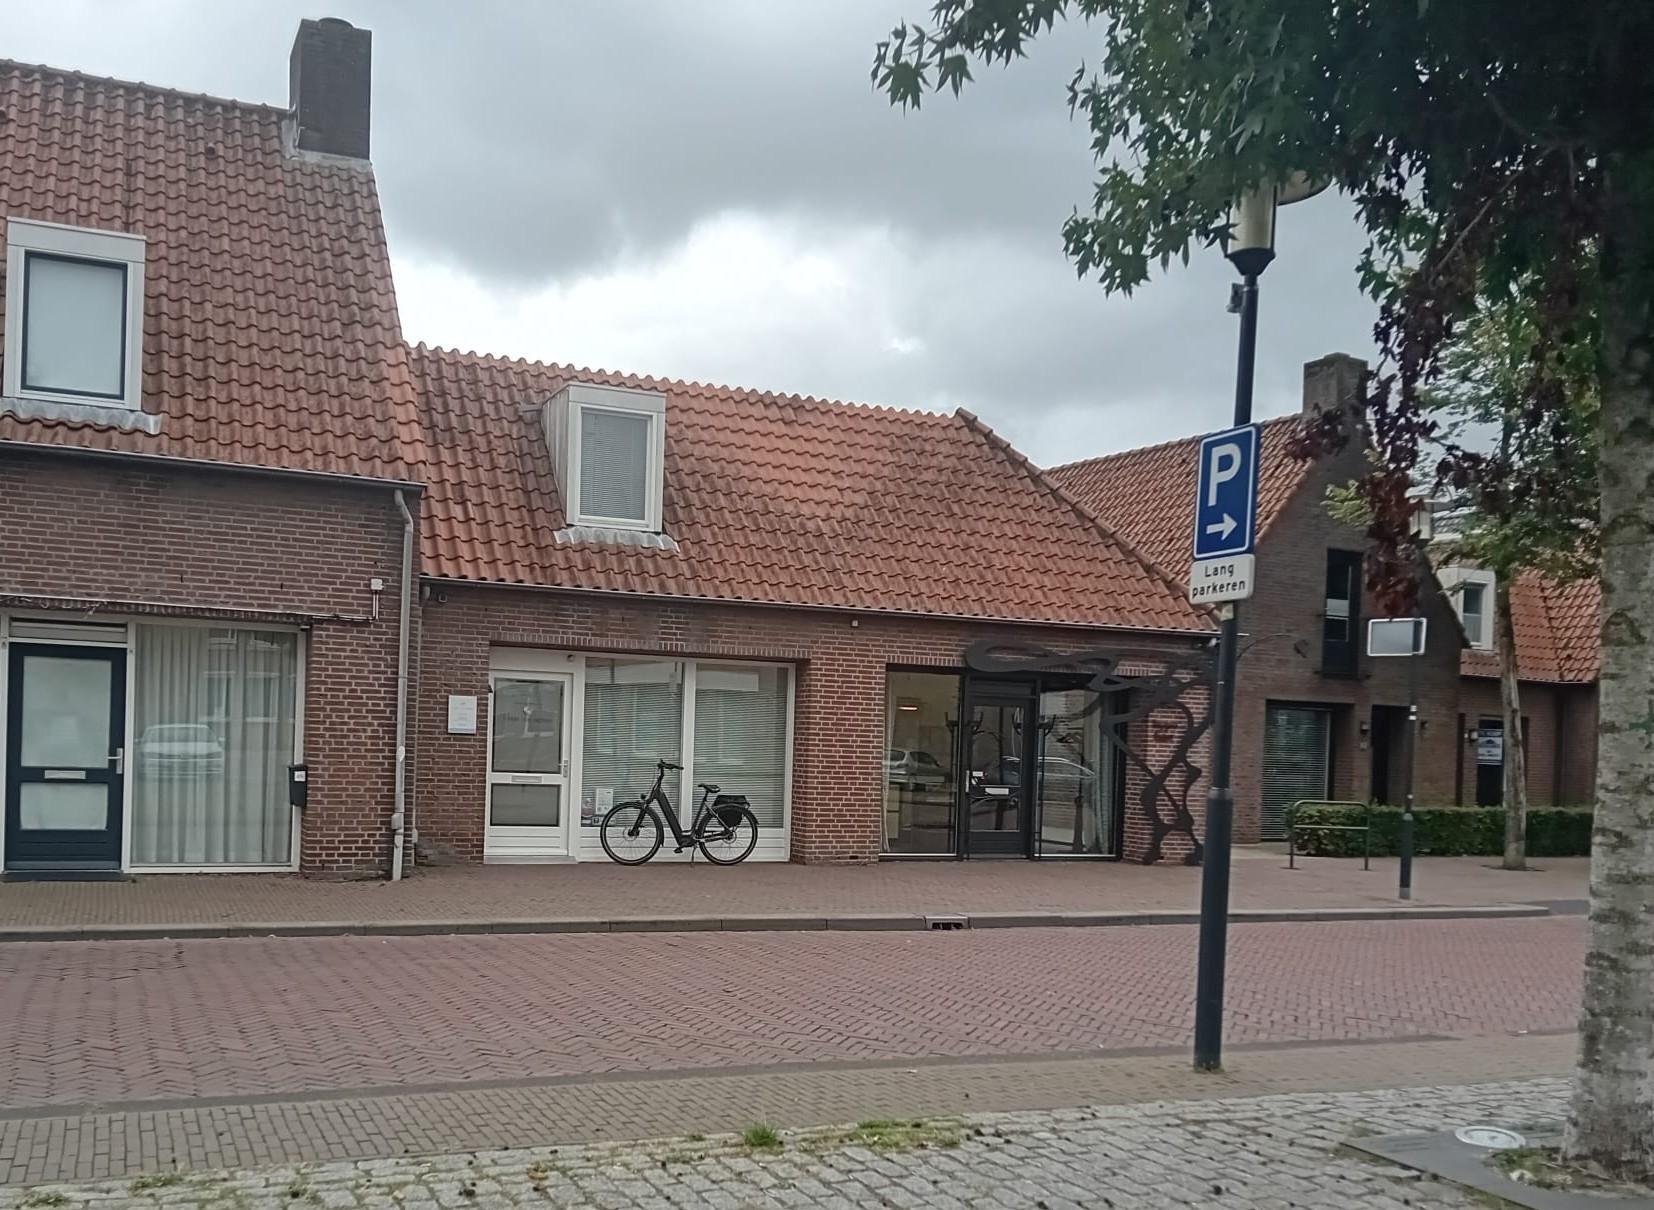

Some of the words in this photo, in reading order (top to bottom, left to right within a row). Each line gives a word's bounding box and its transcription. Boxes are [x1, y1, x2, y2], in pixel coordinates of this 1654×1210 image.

[1207, 442, 1242, 507] P
[1204, 564, 1234, 578] Lang
[1192, 580, 1246, 599] parkeren
